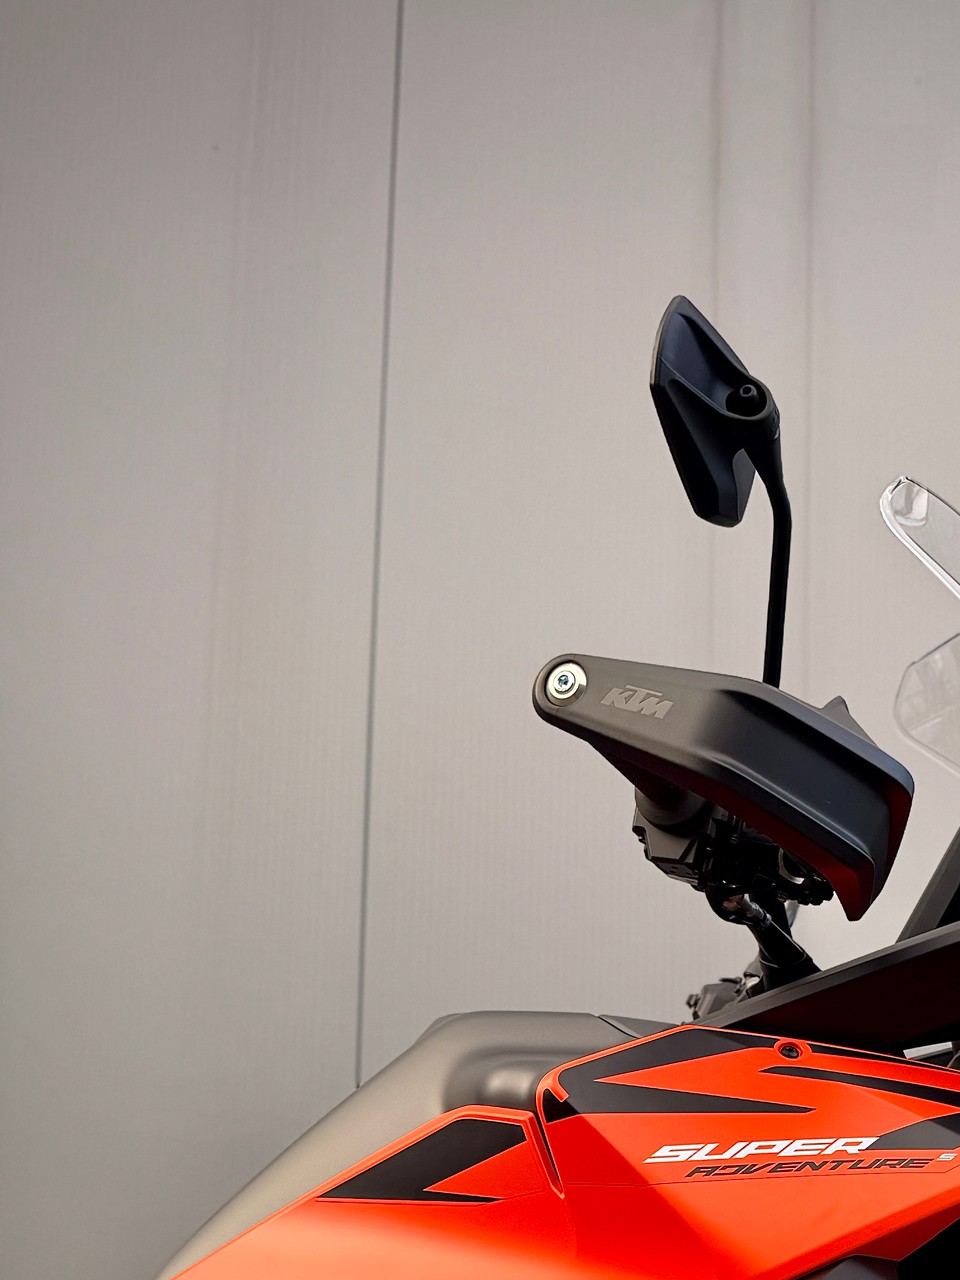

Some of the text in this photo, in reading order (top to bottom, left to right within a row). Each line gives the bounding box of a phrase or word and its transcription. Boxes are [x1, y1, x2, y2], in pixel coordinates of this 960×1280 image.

[600, 684, 674, 719] KTM
[643, 1136, 880, 1164] SUPER
[684, 1157, 935, 1178] ADVENTURE
